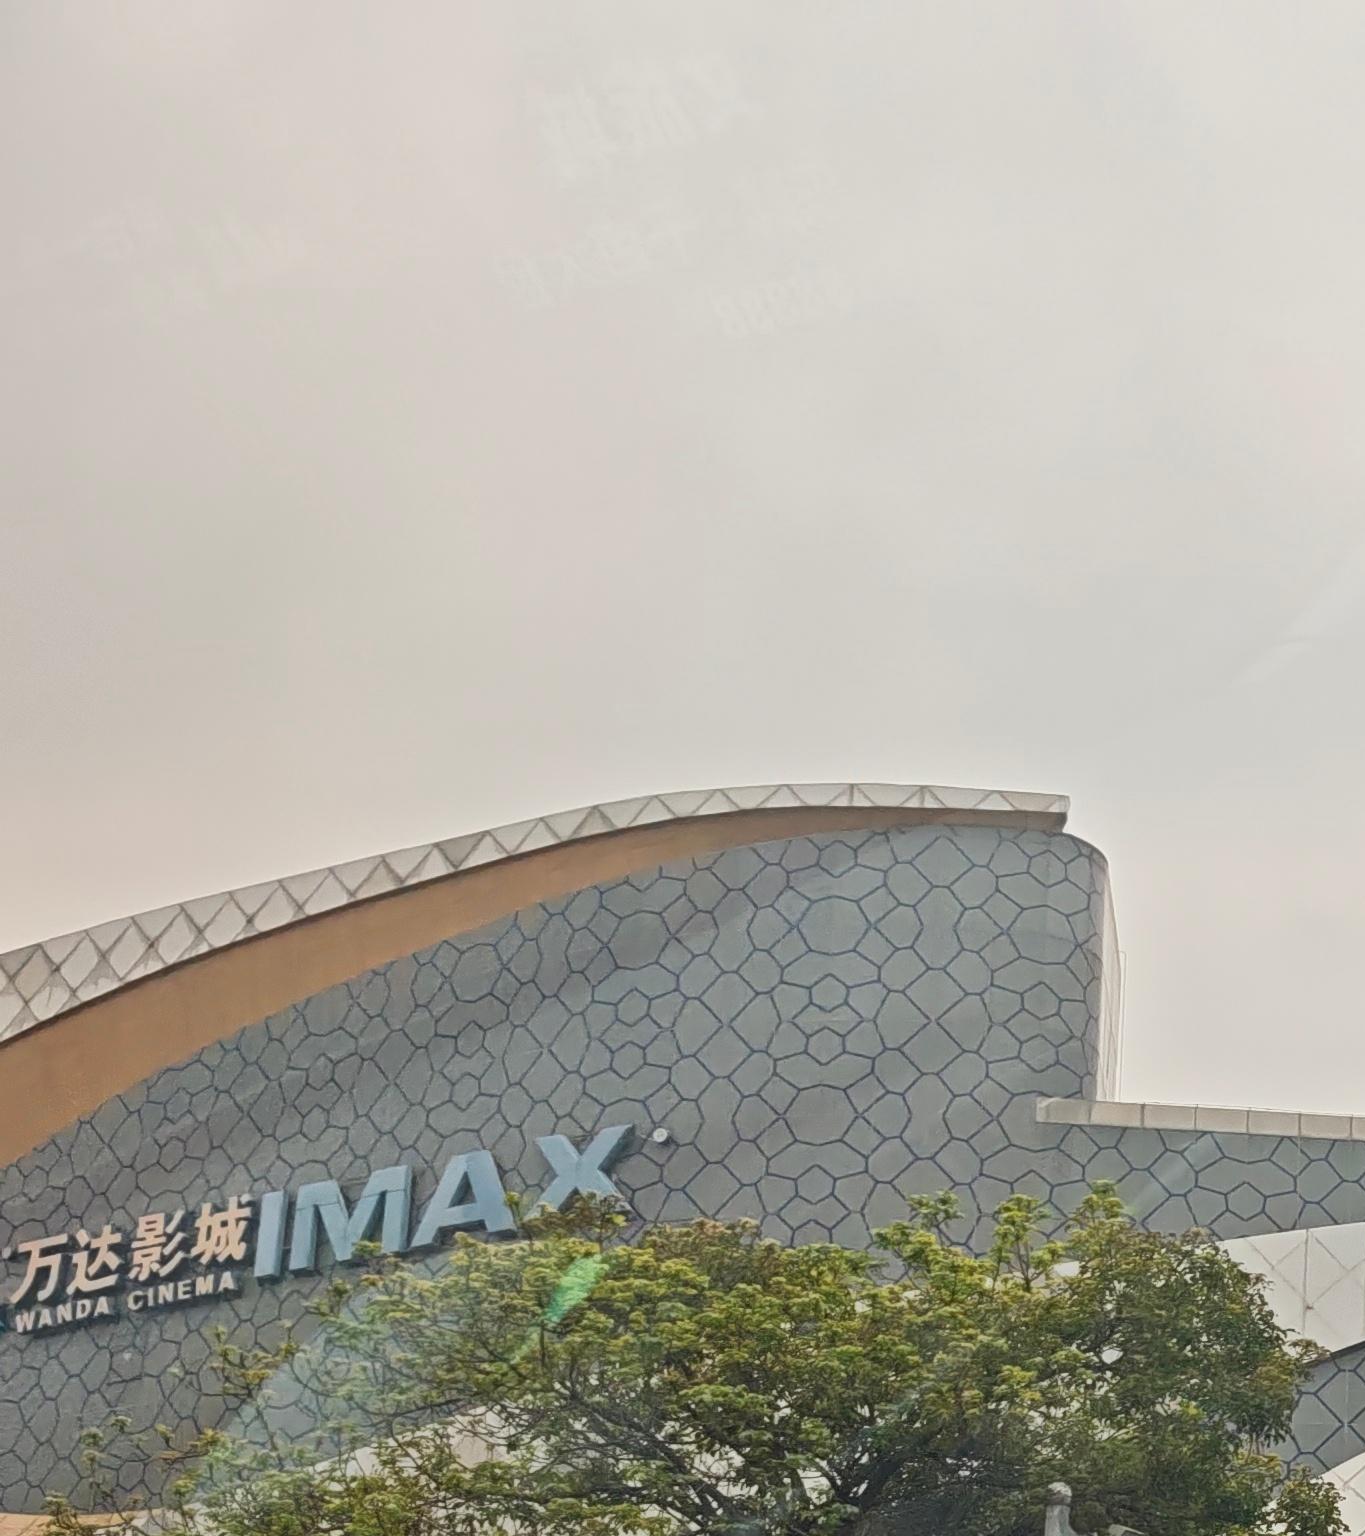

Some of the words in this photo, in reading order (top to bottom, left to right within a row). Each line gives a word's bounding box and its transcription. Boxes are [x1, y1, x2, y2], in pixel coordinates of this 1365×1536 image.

[10, 1194, 253, 1304] 万达影城
[253, 1123, 637, 1282] IMAX
[16, 1296, 110, 1334] WANDA
[126, 1271, 235, 1312] CINEMA
